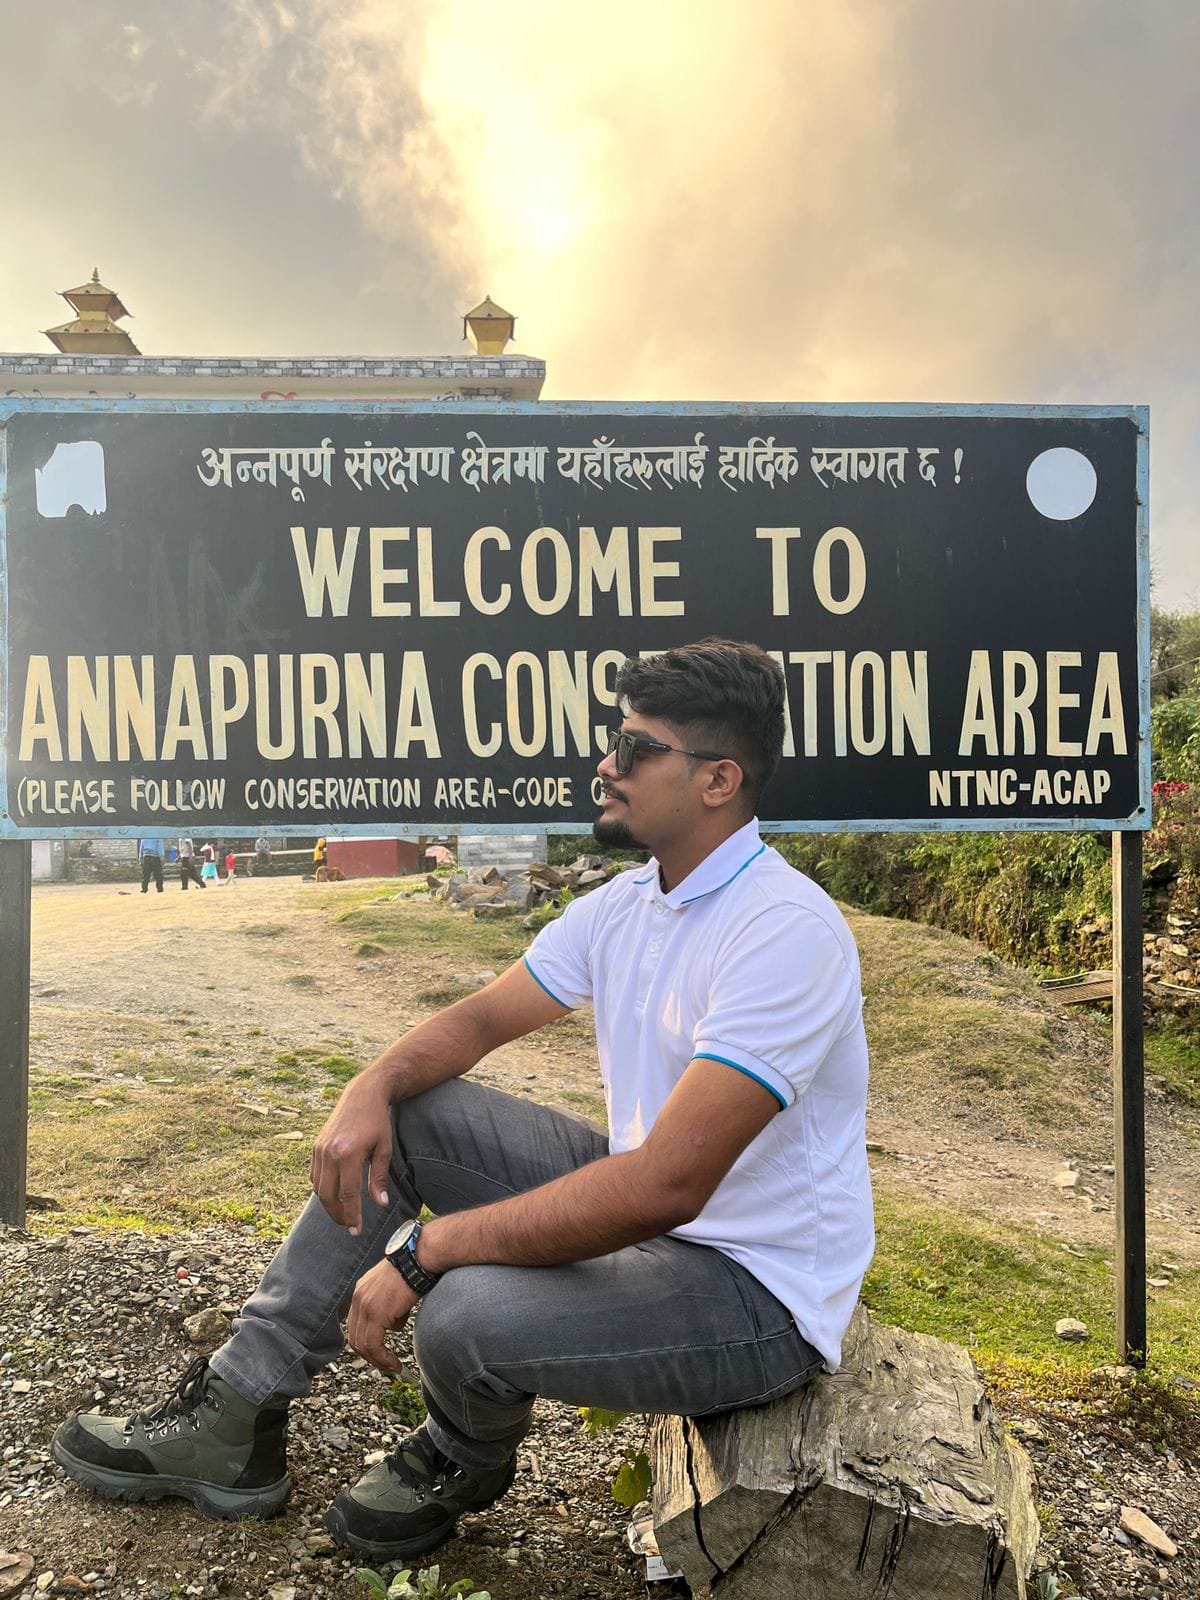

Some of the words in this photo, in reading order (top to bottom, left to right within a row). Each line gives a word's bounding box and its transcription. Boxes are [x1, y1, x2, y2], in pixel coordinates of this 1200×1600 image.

[344, 440, 456, 493] संरक्षण
[460, 431, 550, 493] क्षेत्रमा
[718, 436, 799, 492] हार्दिक
[810, 447, 910, 489] स्वागत
[916, 447, 940, 488] छ
[954, 447, 964, 485] !
[290, 526, 685, 618] WELCOME
[755, 526, 867, 616] TO
[18, 650, 442, 762] ANNAPURNA
[958, 650, 1128, 757] AREA
[17, 776, 117, 817] (PLEASE
[130, 778, 226, 812] FOLLOW
[244, 777, 421, 810] CONSERVATION
[433, 776, 573, 811] AREA-CODE
[929, 768, 1111, 807] NTNC-ACAP
